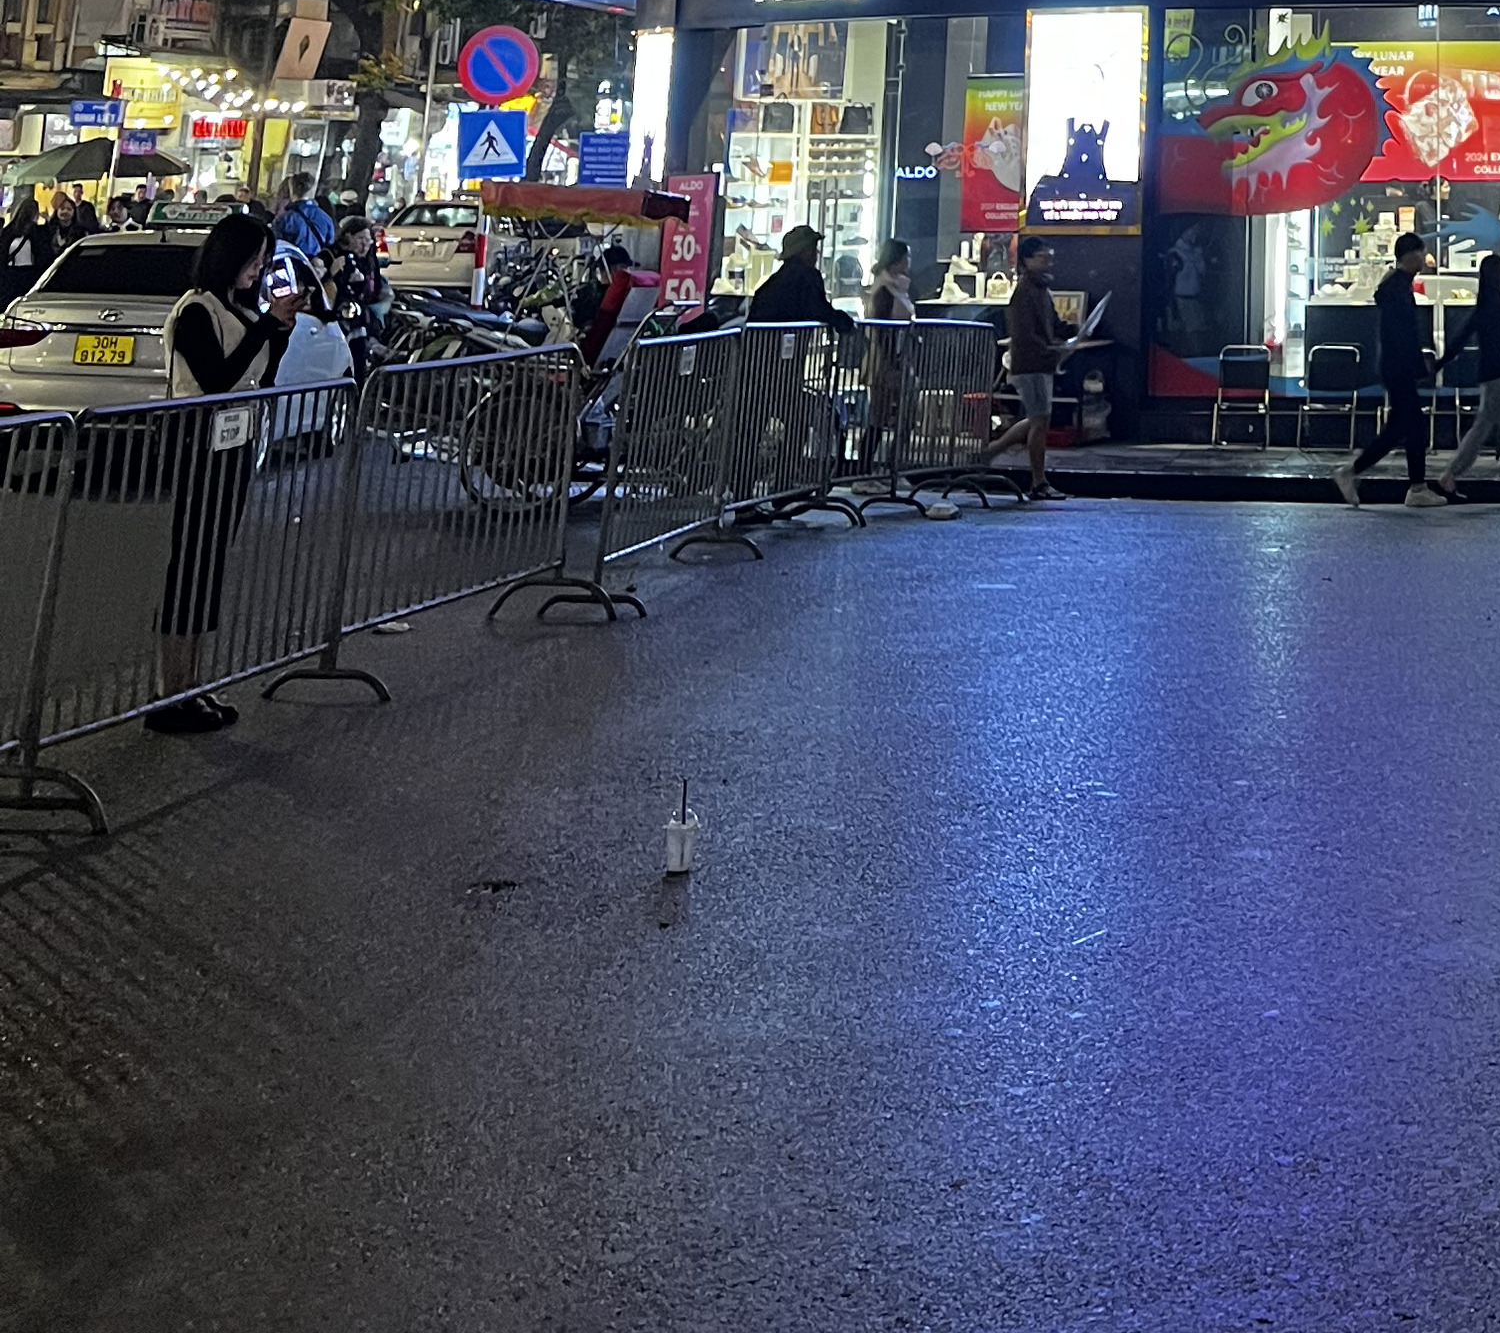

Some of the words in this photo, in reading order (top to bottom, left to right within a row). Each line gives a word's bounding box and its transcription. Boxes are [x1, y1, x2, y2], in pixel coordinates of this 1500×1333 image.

[1373, 50, 1414, 61] LUNAR
[1373, 65, 1405, 76] YEAR
[984, 101, 1007, 111] NEW
[1464, 152, 1489, 163] 2024
[894, 165, 938, 179] ALDO
[678, 180, 704, 192] ALDO
[92, 336, 119, 349] 30H
